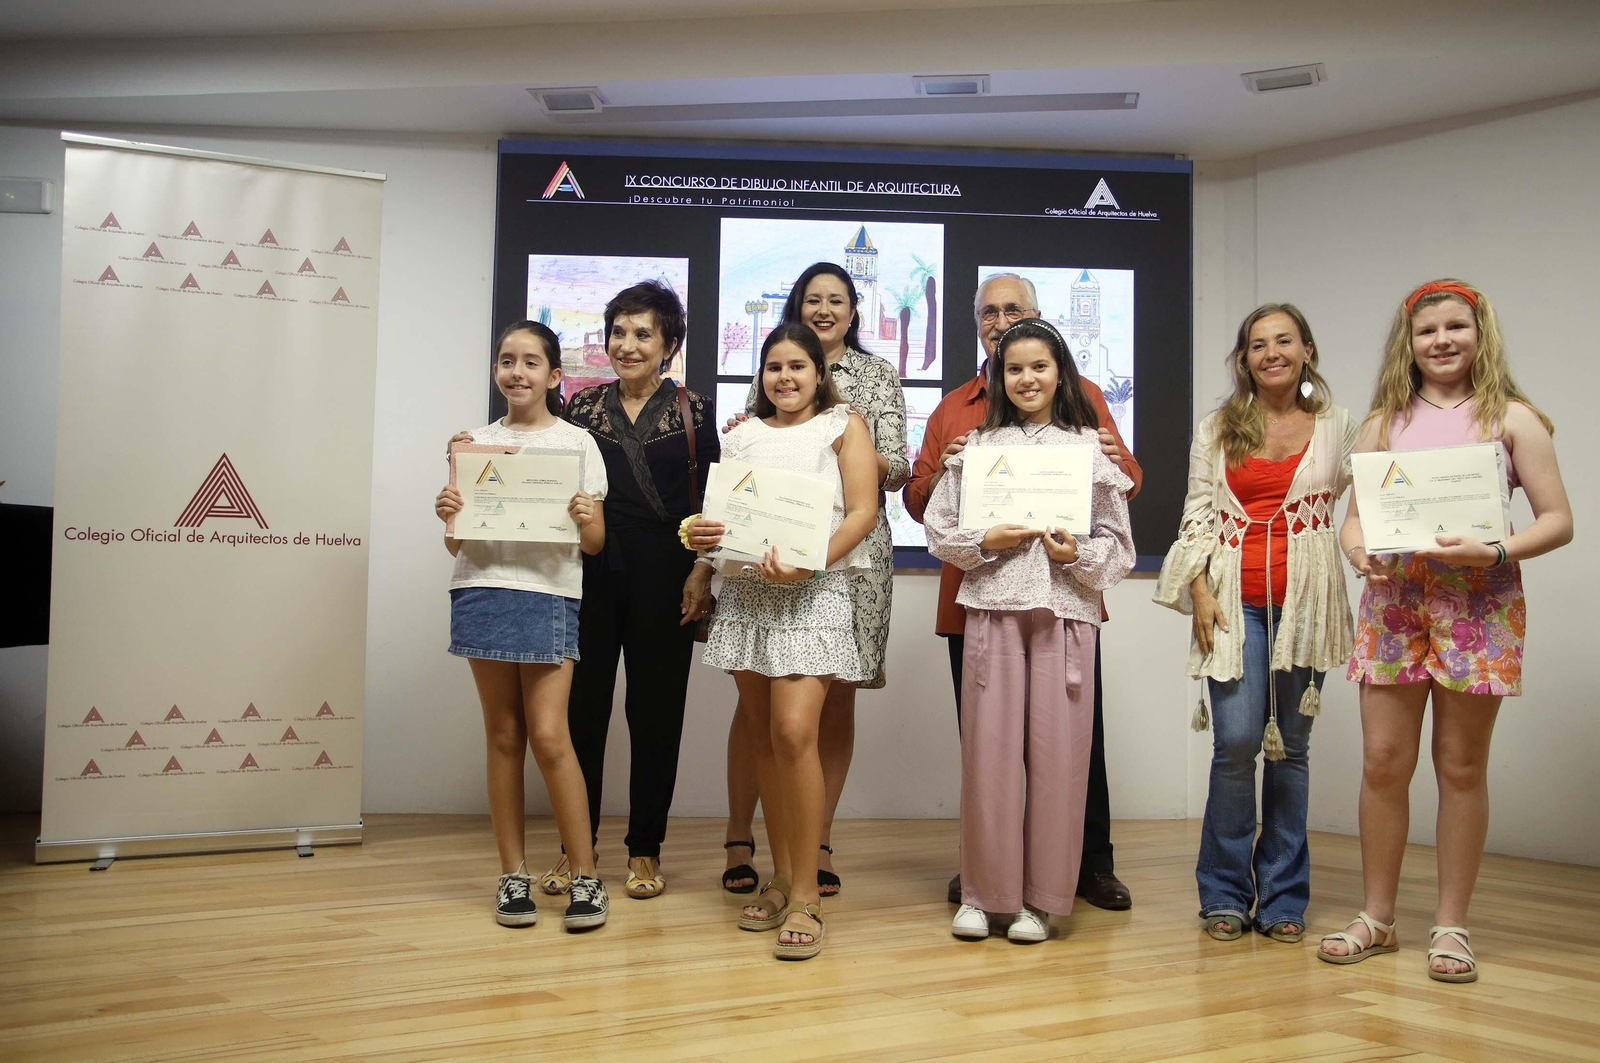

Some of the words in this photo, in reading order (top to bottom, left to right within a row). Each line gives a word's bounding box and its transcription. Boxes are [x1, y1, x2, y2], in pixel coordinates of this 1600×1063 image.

[625, 175, 637, 186] IX
[640, 175, 716, 188] CONCURSO
[721, 178, 737, 189] DE
[741, 178, 787, 190] DIBUJO
[791, 180, 843, 191] INFANTIL
[848, 181, 864, 192] DE
[868, 182, 960, 195] ARQUITECTURA
[701, 196, 712, 205] tu
[722, 197, 794, 207] Patrimonio!
[1045, 208, 1067, 216] Colegio
[64, 527, 125, 545] Colegio
[130, 528, 181, 542] Oficial
[186, 529, 205, 543] de
[210, 530, 288, 547] Arquitectos
[293, 532, 310, 546] de
[315, 534, 361, 547] Huelva
